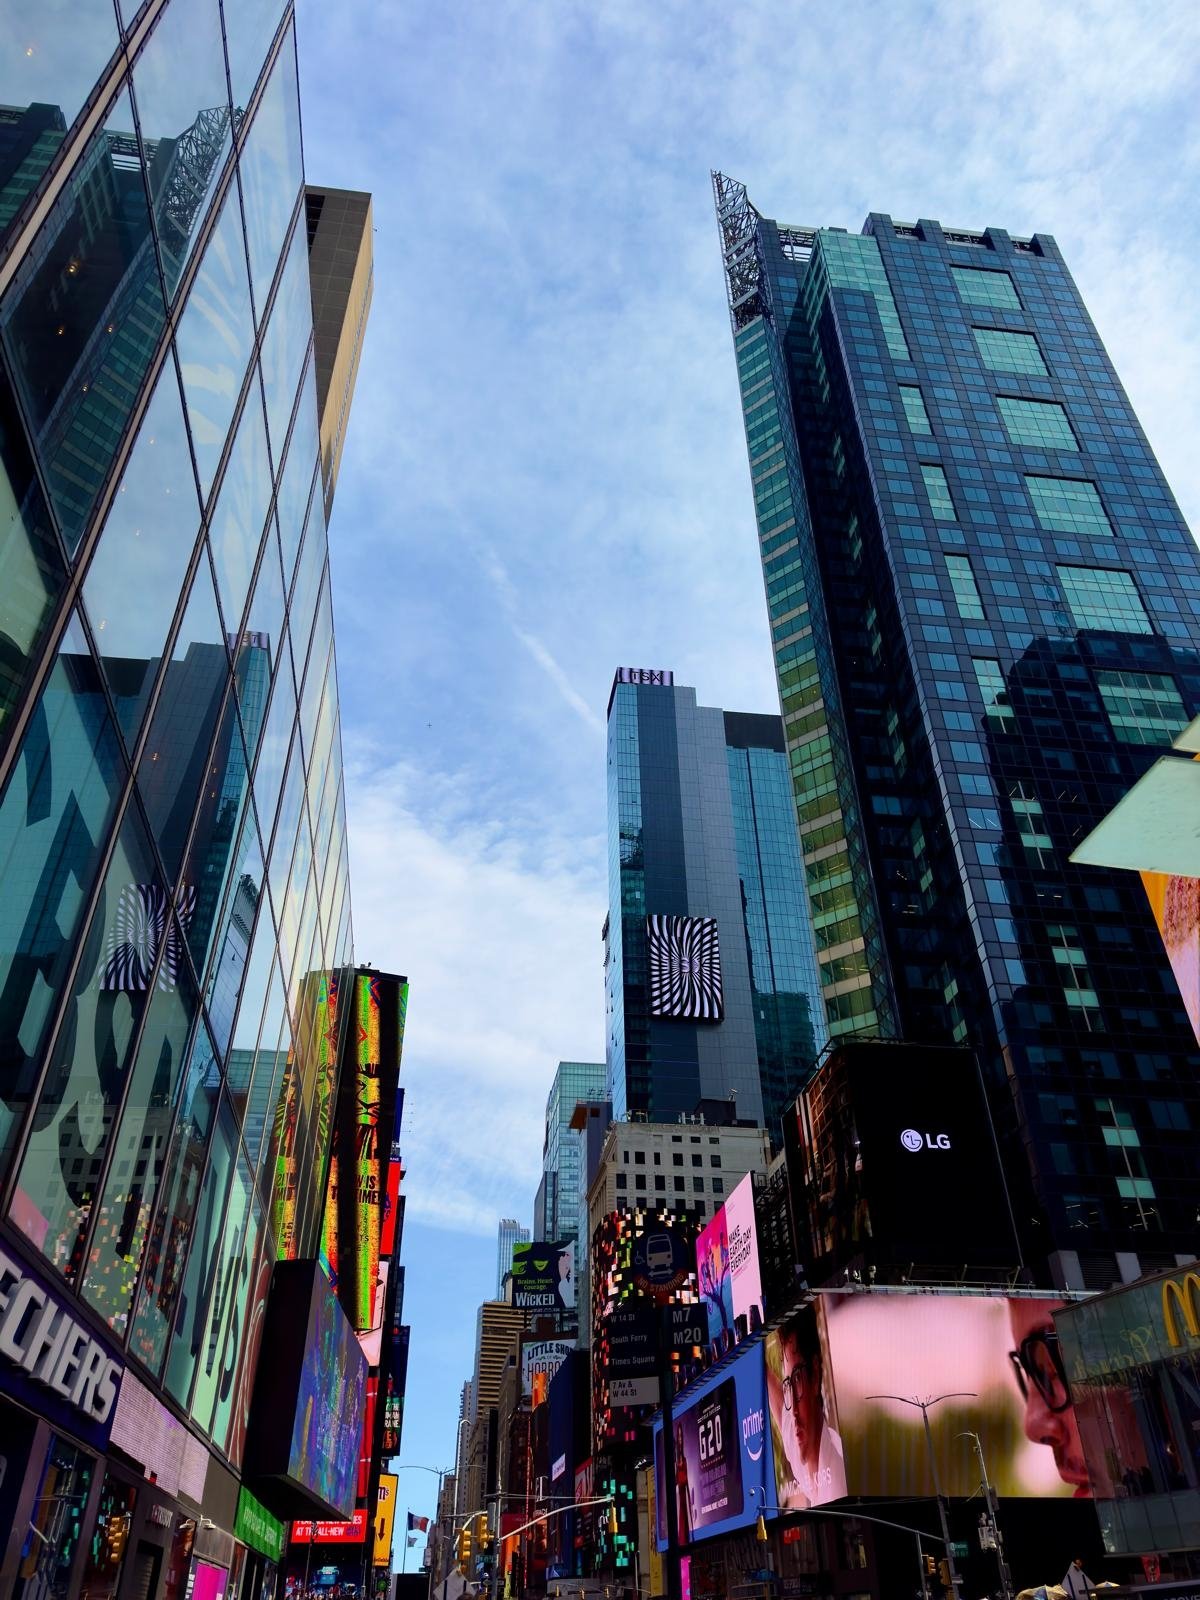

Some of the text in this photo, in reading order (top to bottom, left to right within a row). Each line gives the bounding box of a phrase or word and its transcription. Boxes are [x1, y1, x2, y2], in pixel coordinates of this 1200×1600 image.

[631, 671, 661, 682] TSX
[925, 1133, 951, 1149] LG
[112, 1030, 249, 1402] NEWS
[728, 1224, 740, 1243] MAKE
[729, 1236, 743, 1260] EARTH
[742, 1226, 752, 1244] DAY
[637, 1272, 685, 1292] NO STANDING
[610, 1315, 617, 1323] W
[628, 1313, 635, 1321] St
[672, 1306, 691, 1323] M7
[610, 1334, 648, 1344] South Ferry
[673, 1327, 702, 1345] M20
[527, 1343, 554, 1361] LITTLE
[611, 1356, 655, 1366] Times Square
[742, 1408, 764, 1446] prime
[699, 1414, 723, 1461] G20
[295, 1527, 303, 1536] AT
